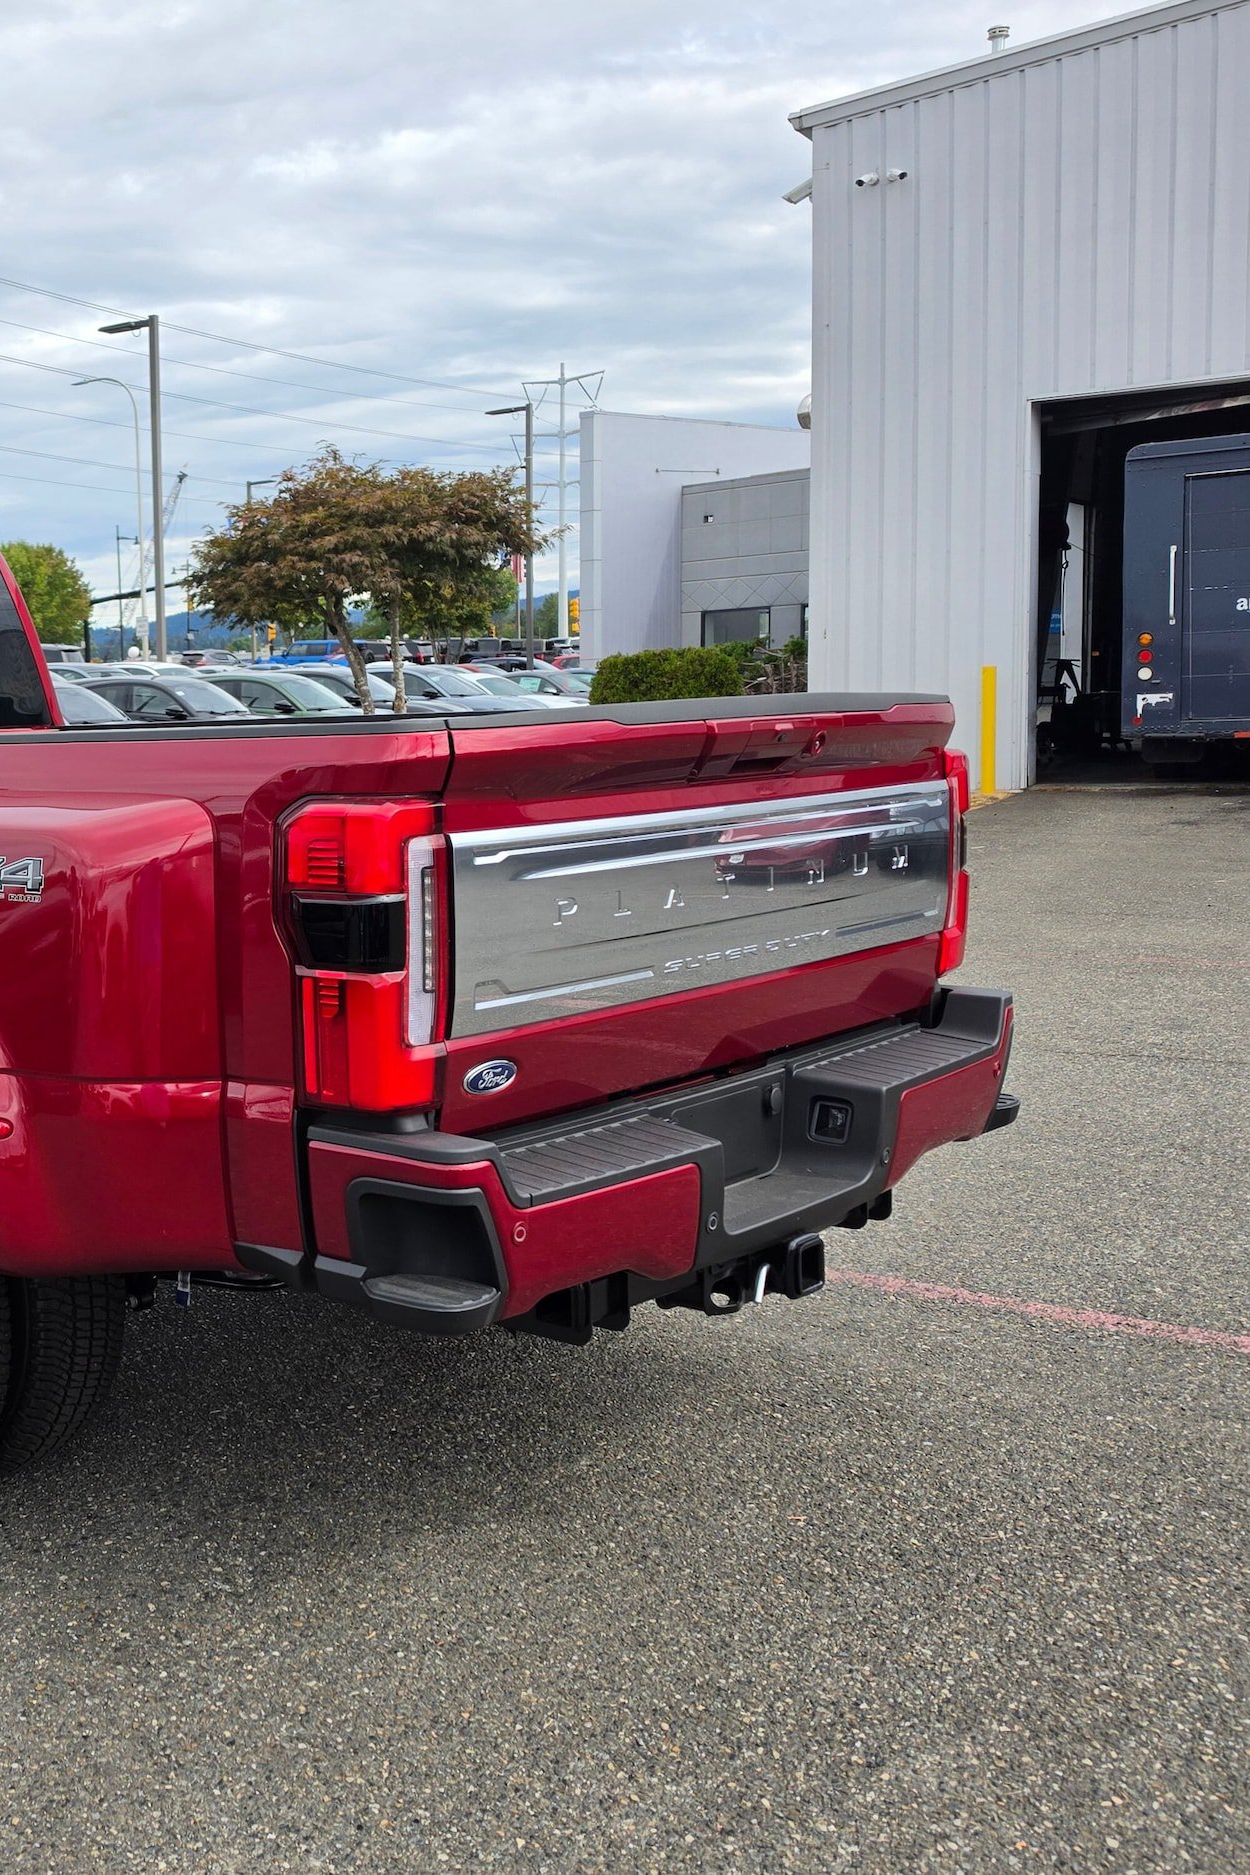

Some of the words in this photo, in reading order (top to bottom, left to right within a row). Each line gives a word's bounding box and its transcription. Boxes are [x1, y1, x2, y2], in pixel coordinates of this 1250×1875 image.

[7, 893, 42, 903] ROAD
[552, 844, 910, 926] PLATINUM
[663, 944, 759, 973] SUPER
[766, 929, 831, 952] DUTY
[477, 1067, 509, 1090] Ford
